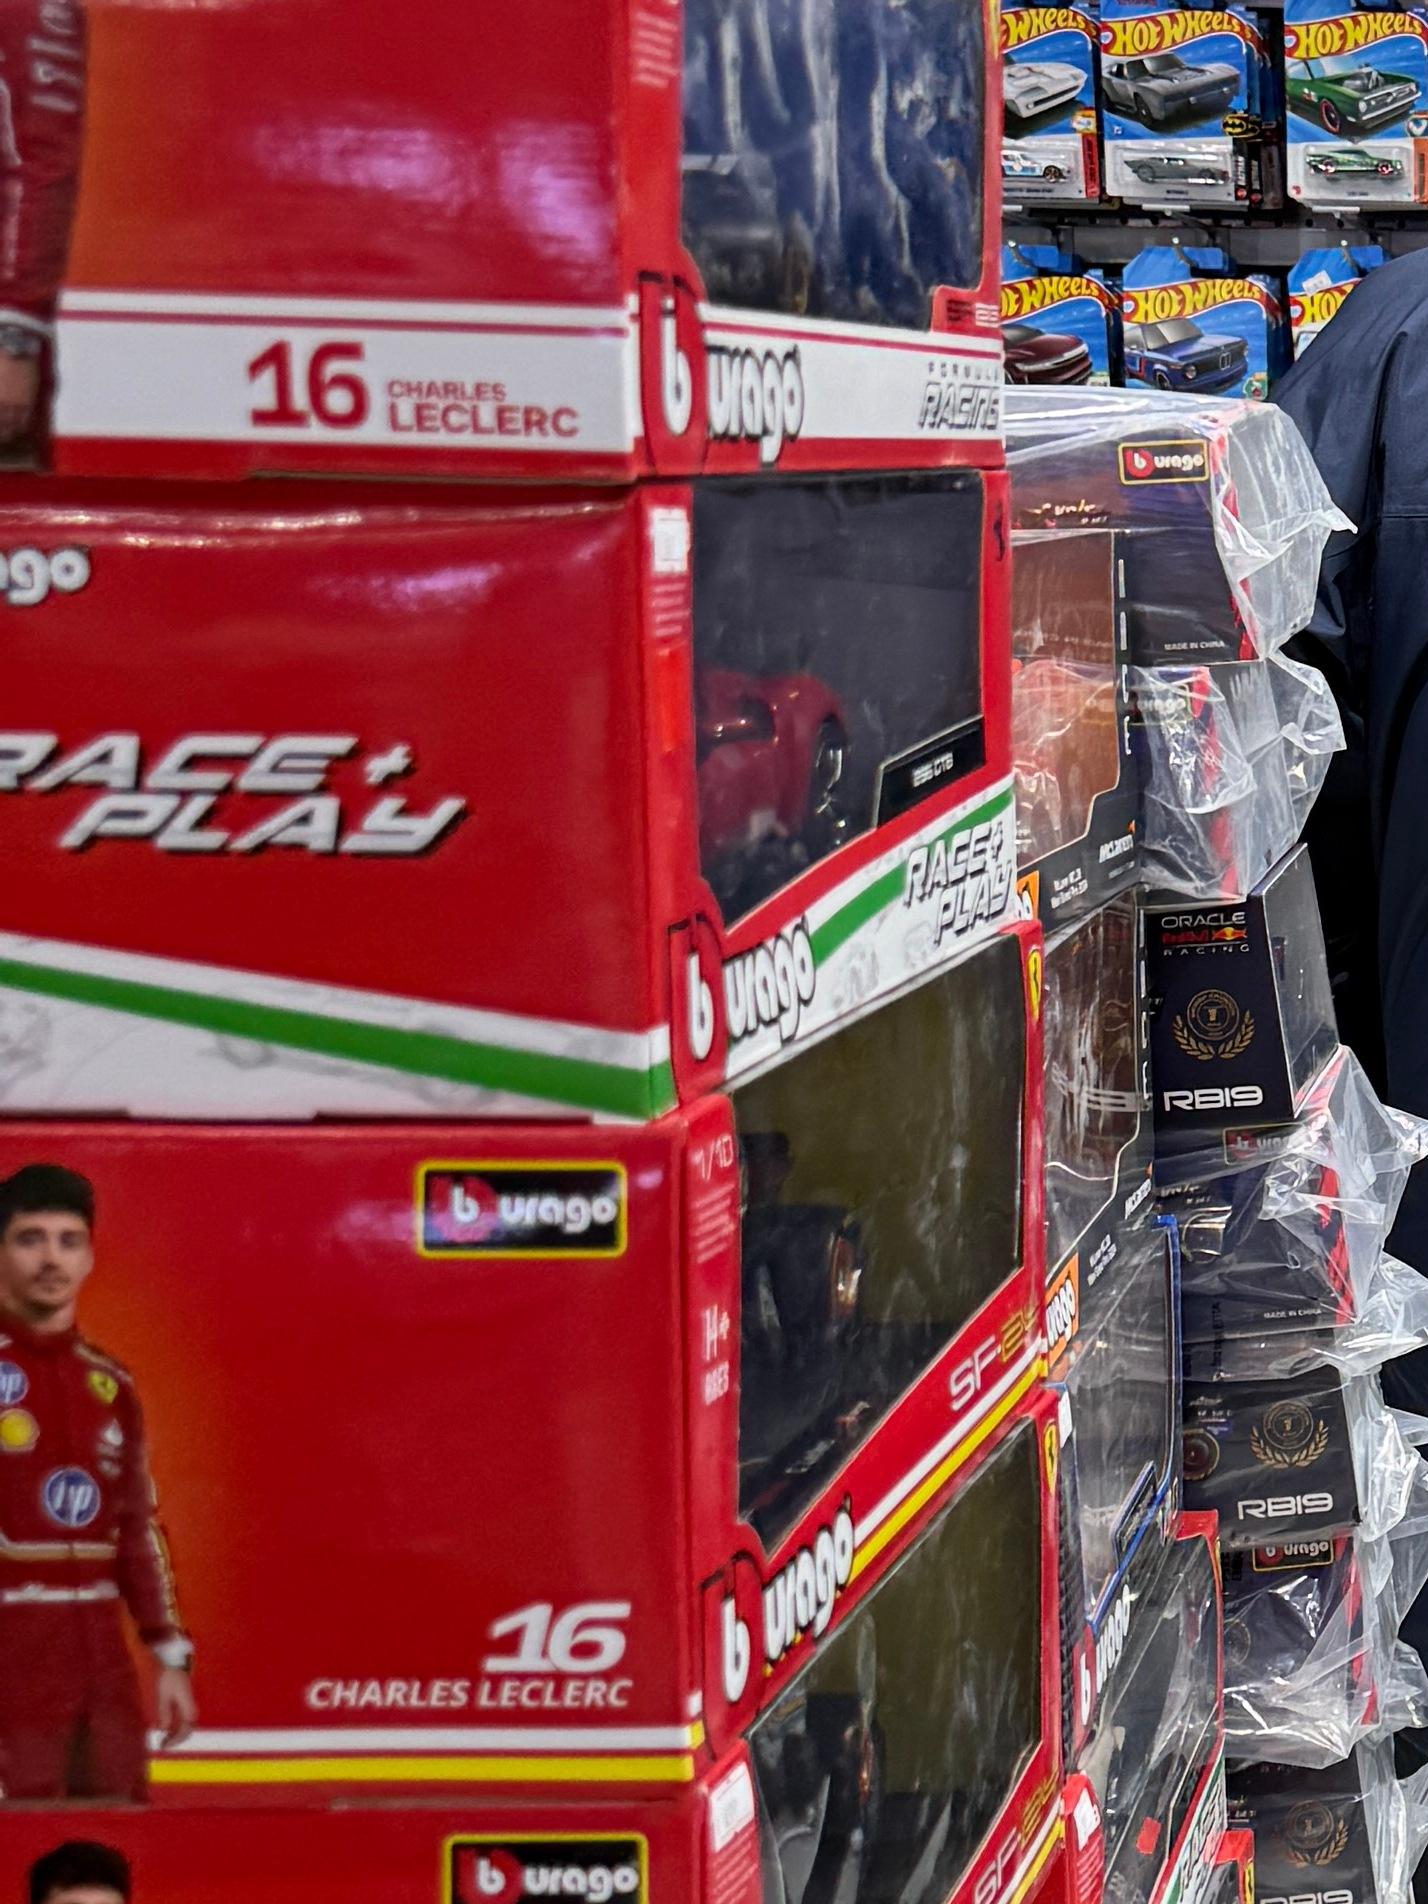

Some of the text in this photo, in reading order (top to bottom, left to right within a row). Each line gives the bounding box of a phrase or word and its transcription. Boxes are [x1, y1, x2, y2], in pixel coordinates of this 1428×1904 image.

[1112, 11, 1238, 57] HOT WHEELS
[1297, 12, 1420, 60] HOT WHEELS
[246, 340, 369, 428] 16
[386, 378, 508, 403] CHARLES
[664, 301, 805, 463] burago
[387, 401, 580, 439] LECLERC
[1131, 448, 1205, 478] burago
[56, 793, 467, 858] PLAY
[902, 821, 993, 910] RACE
[933, 858, 1014, 946] PLAY
[1160, 909, 1247, 929] ORACLE
[1162, 943, 1250, 956] RACING
[686, 919, 816, 1063] burago
[1163, 1084, 1264, 1112] RB19
[450, 1182, 619, 1231] burago
[1236, 1491, 1334, 1520] RB19
[719, 1506, 855, 1704] burago
[482, 1601, 633, 1675] 16
[307, 1678, 634, 1710] CHARLES LECLERC
[473, 1856, 642, 1903] burago
